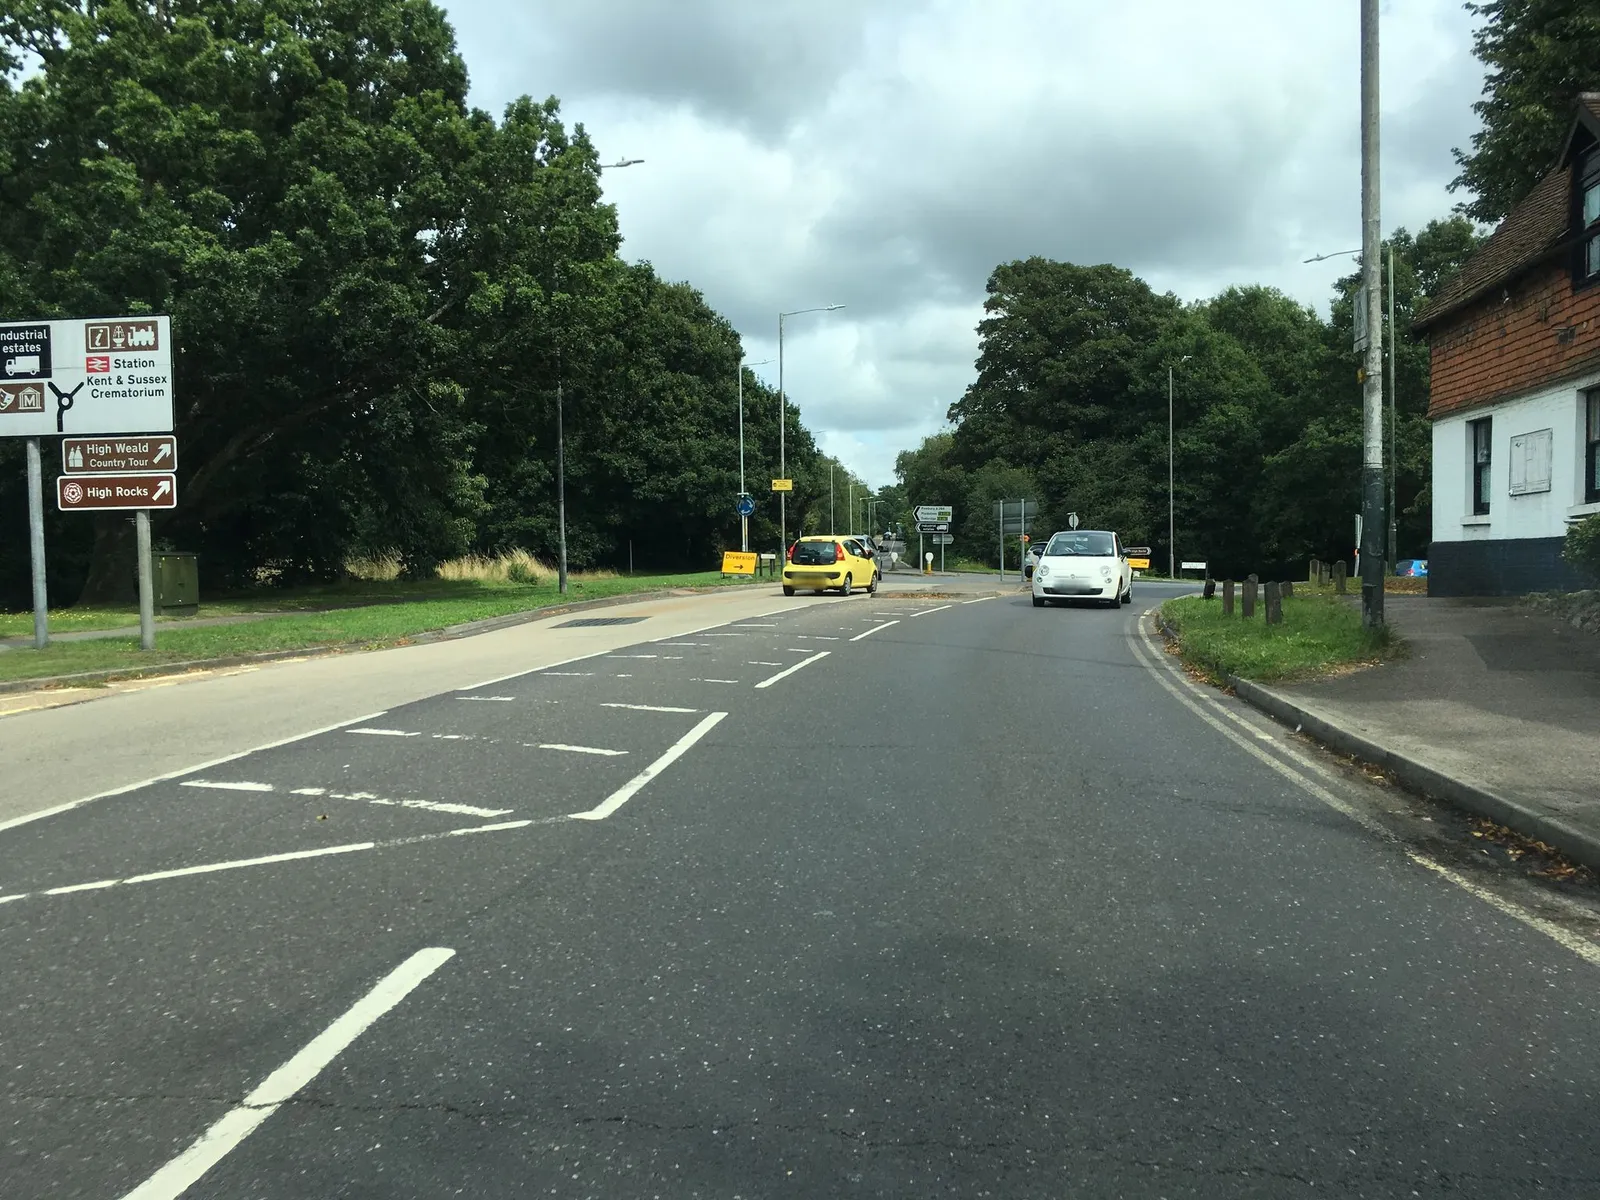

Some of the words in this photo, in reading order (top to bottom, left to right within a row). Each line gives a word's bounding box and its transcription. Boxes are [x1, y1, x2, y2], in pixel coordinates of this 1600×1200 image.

[0, 329, 48, 341] ndustrial
[2, 342, 42, 353] estates
[113, 358, 155, 369] Station
[86, 375, 113, 386] Kent
[116, 375, 125, 385] &
[127, 374, 168, 385] Sussex
[91, 388, 165, 399] Crematorium
[86, 444, 112, 456] High
[115, 442, 149, 454] Weald
[89, 458, 126, 469] Country
[128, 457, 149, 467] Tour
[87, 487, 113, 499] High
[116, 486, 149, 497] Rocks
[725, 553, 756, 561] Diversion
